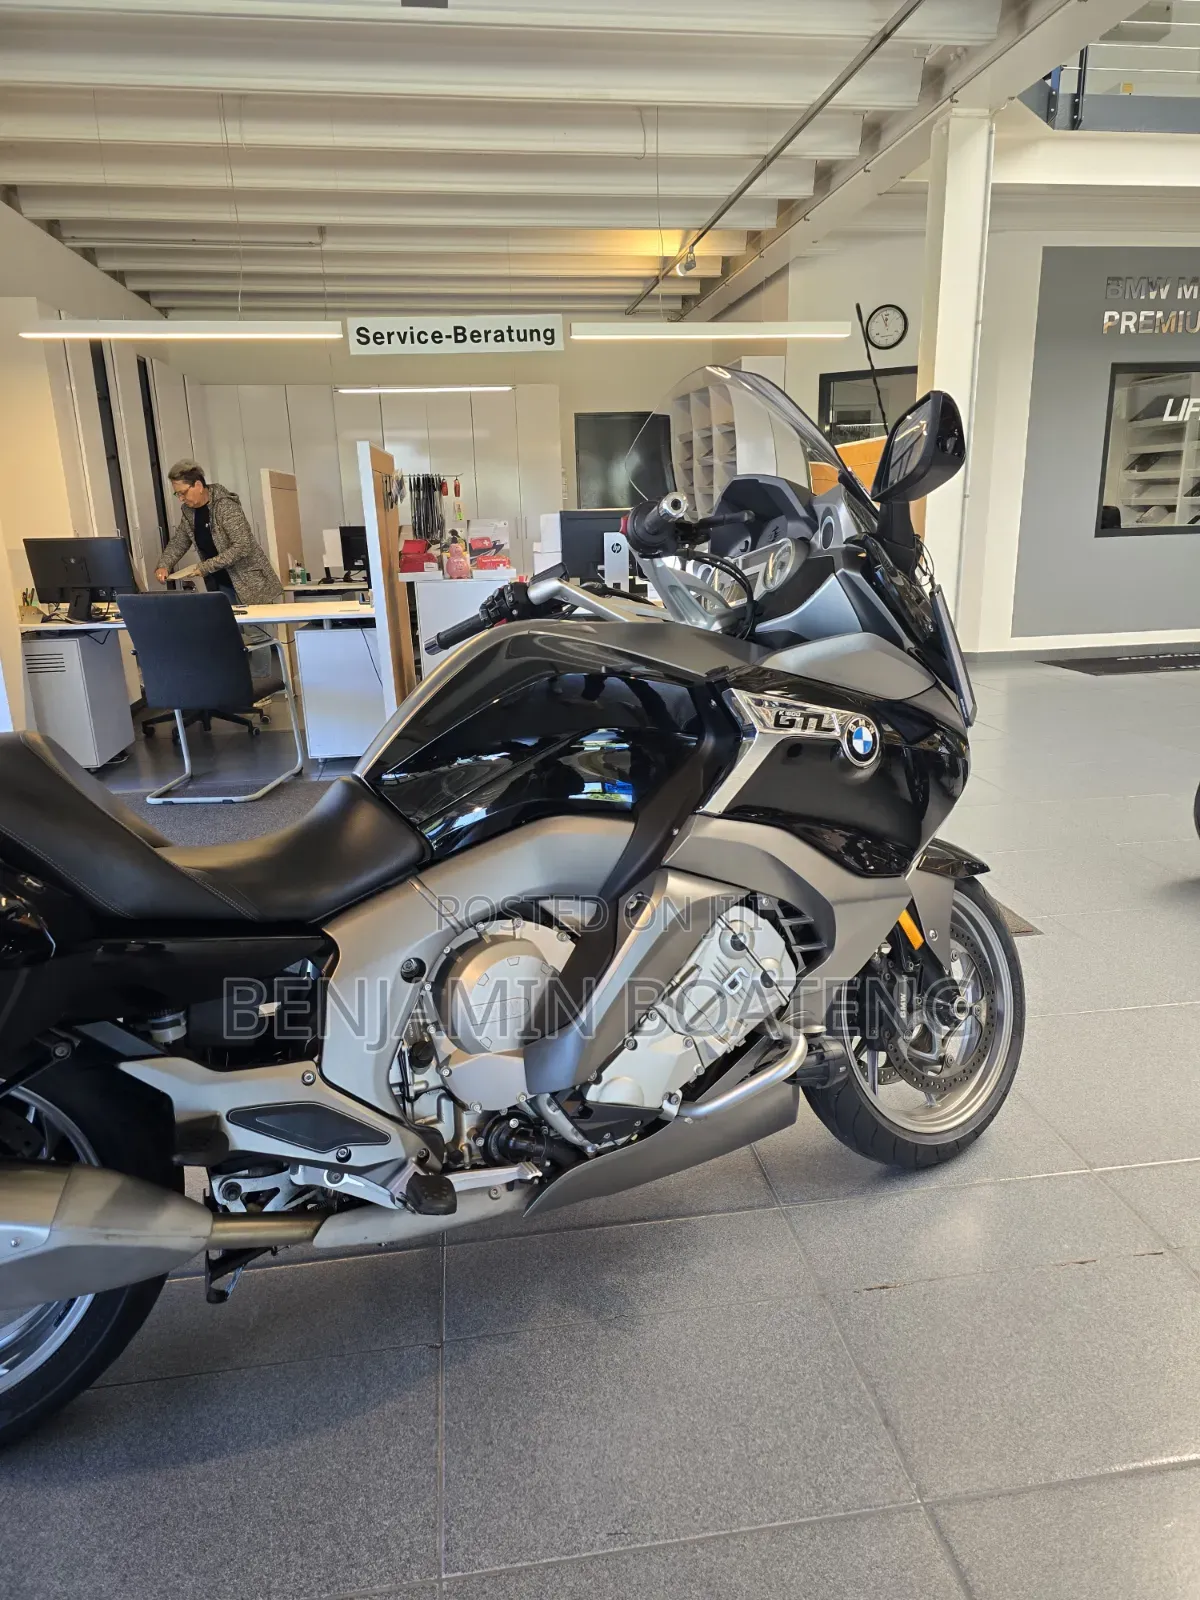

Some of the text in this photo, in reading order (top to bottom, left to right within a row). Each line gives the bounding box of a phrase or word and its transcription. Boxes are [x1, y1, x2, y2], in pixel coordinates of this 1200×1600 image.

[1106, 276, 1172, 300] BMW
[355, 325, 555, 346] Service-Beratung
[1162, 398, 1200, 421] LIF
[774, 711, 835, 732] GTL
